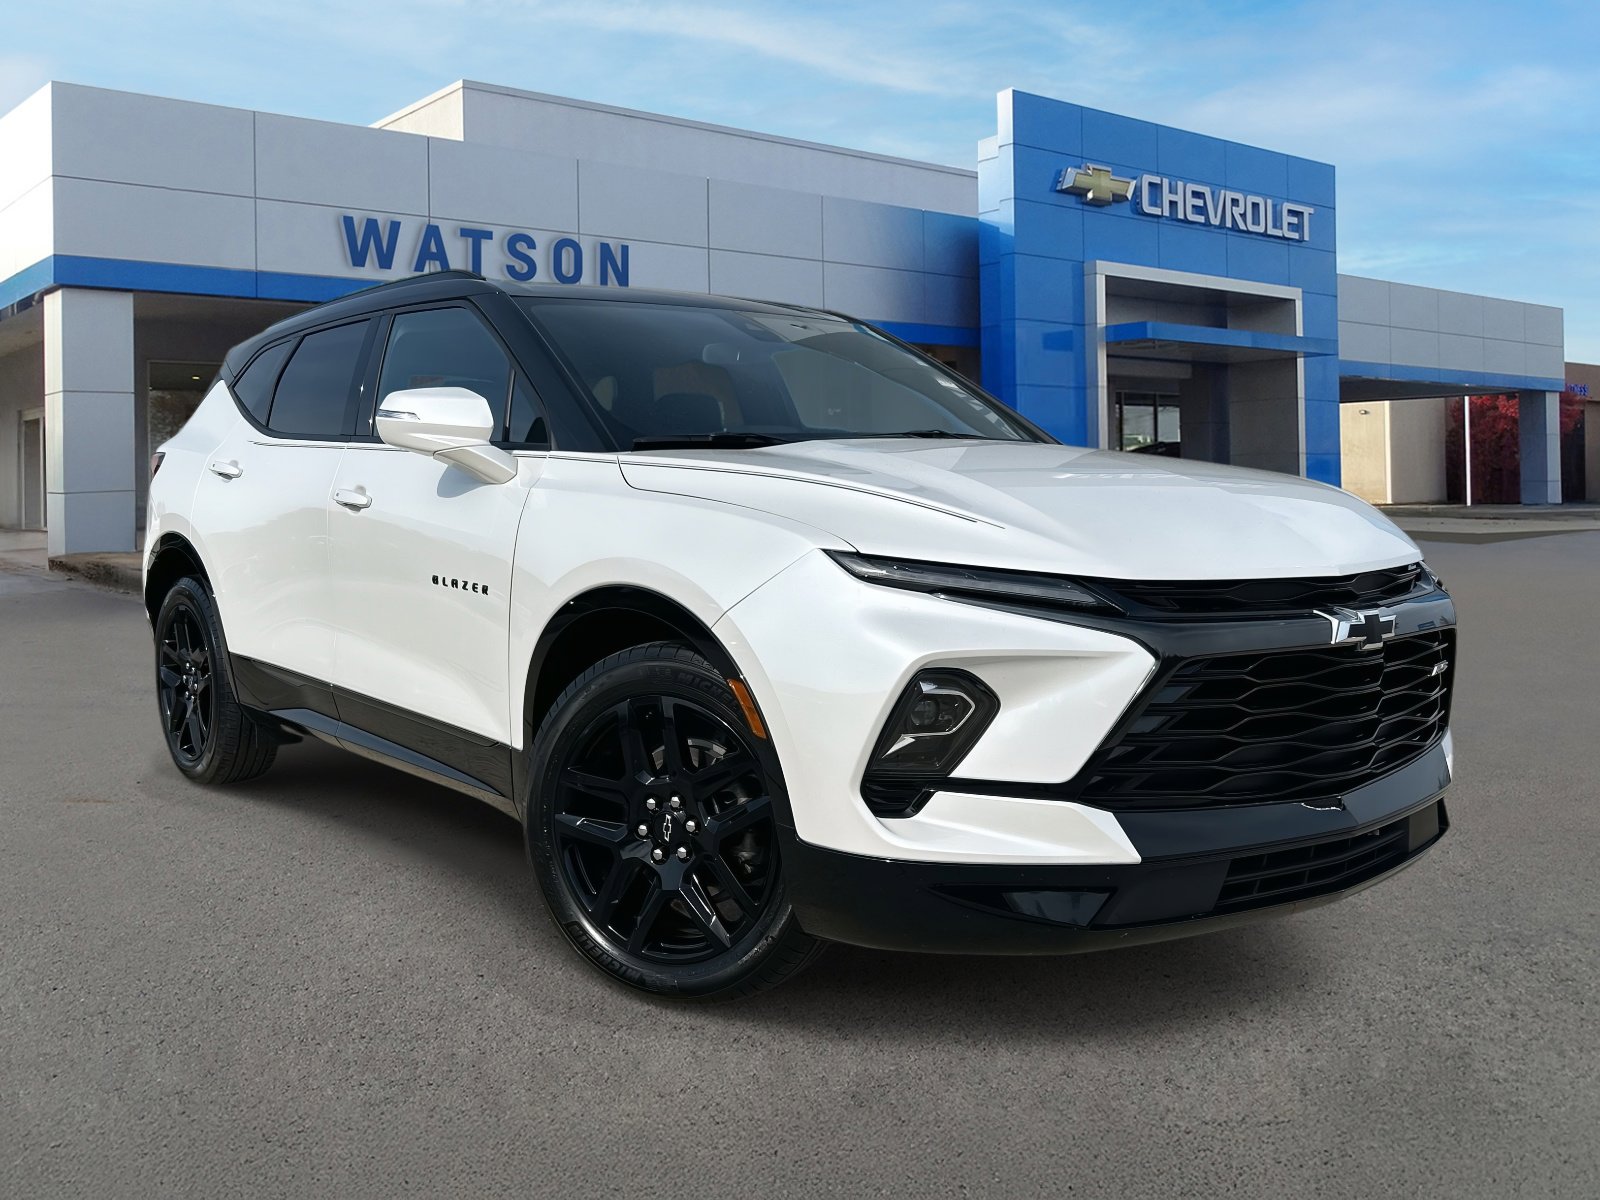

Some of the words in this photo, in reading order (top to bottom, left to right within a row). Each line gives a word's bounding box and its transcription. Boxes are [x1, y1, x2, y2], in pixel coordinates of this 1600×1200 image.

[1141, 173, 1314, 241] CHEVROLET
[342, 215, 629, 287] WATSON
[431, 574, 489, 596] BLAZER
